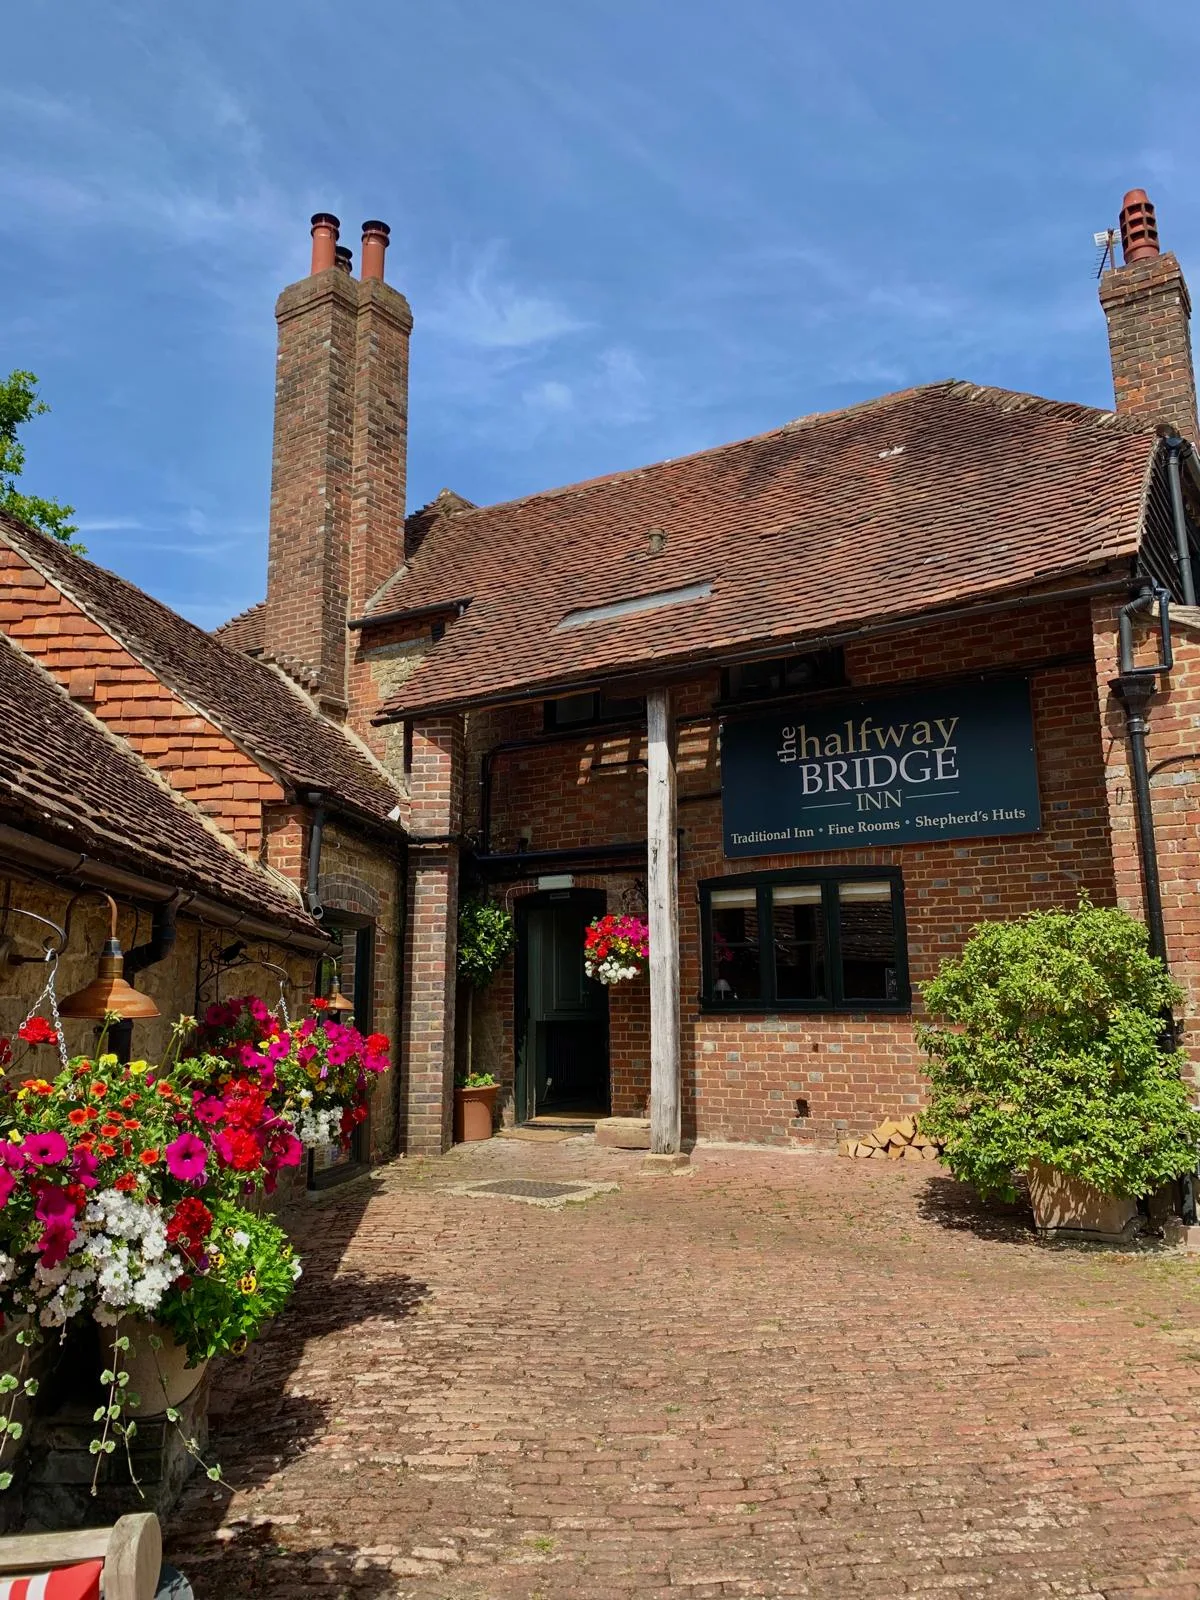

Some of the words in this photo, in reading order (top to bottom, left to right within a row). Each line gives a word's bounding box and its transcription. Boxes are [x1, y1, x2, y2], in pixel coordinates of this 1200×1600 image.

[777, 726, 797, 764] the
[798, 717, 959, 760] halfway
[800, 746, 960, 795] BRIDGE
[856, 789, 903, 812] INN
[731, 828, 791, 844] Traditional
[794, 827, 815, 838] Inn
[828, 823, 855, 835] Fine
[857, 820, 900, 833] Rooms
[915, 810, 989, 828] Shepherd's
[991, 808, 1026, 821] Huts
